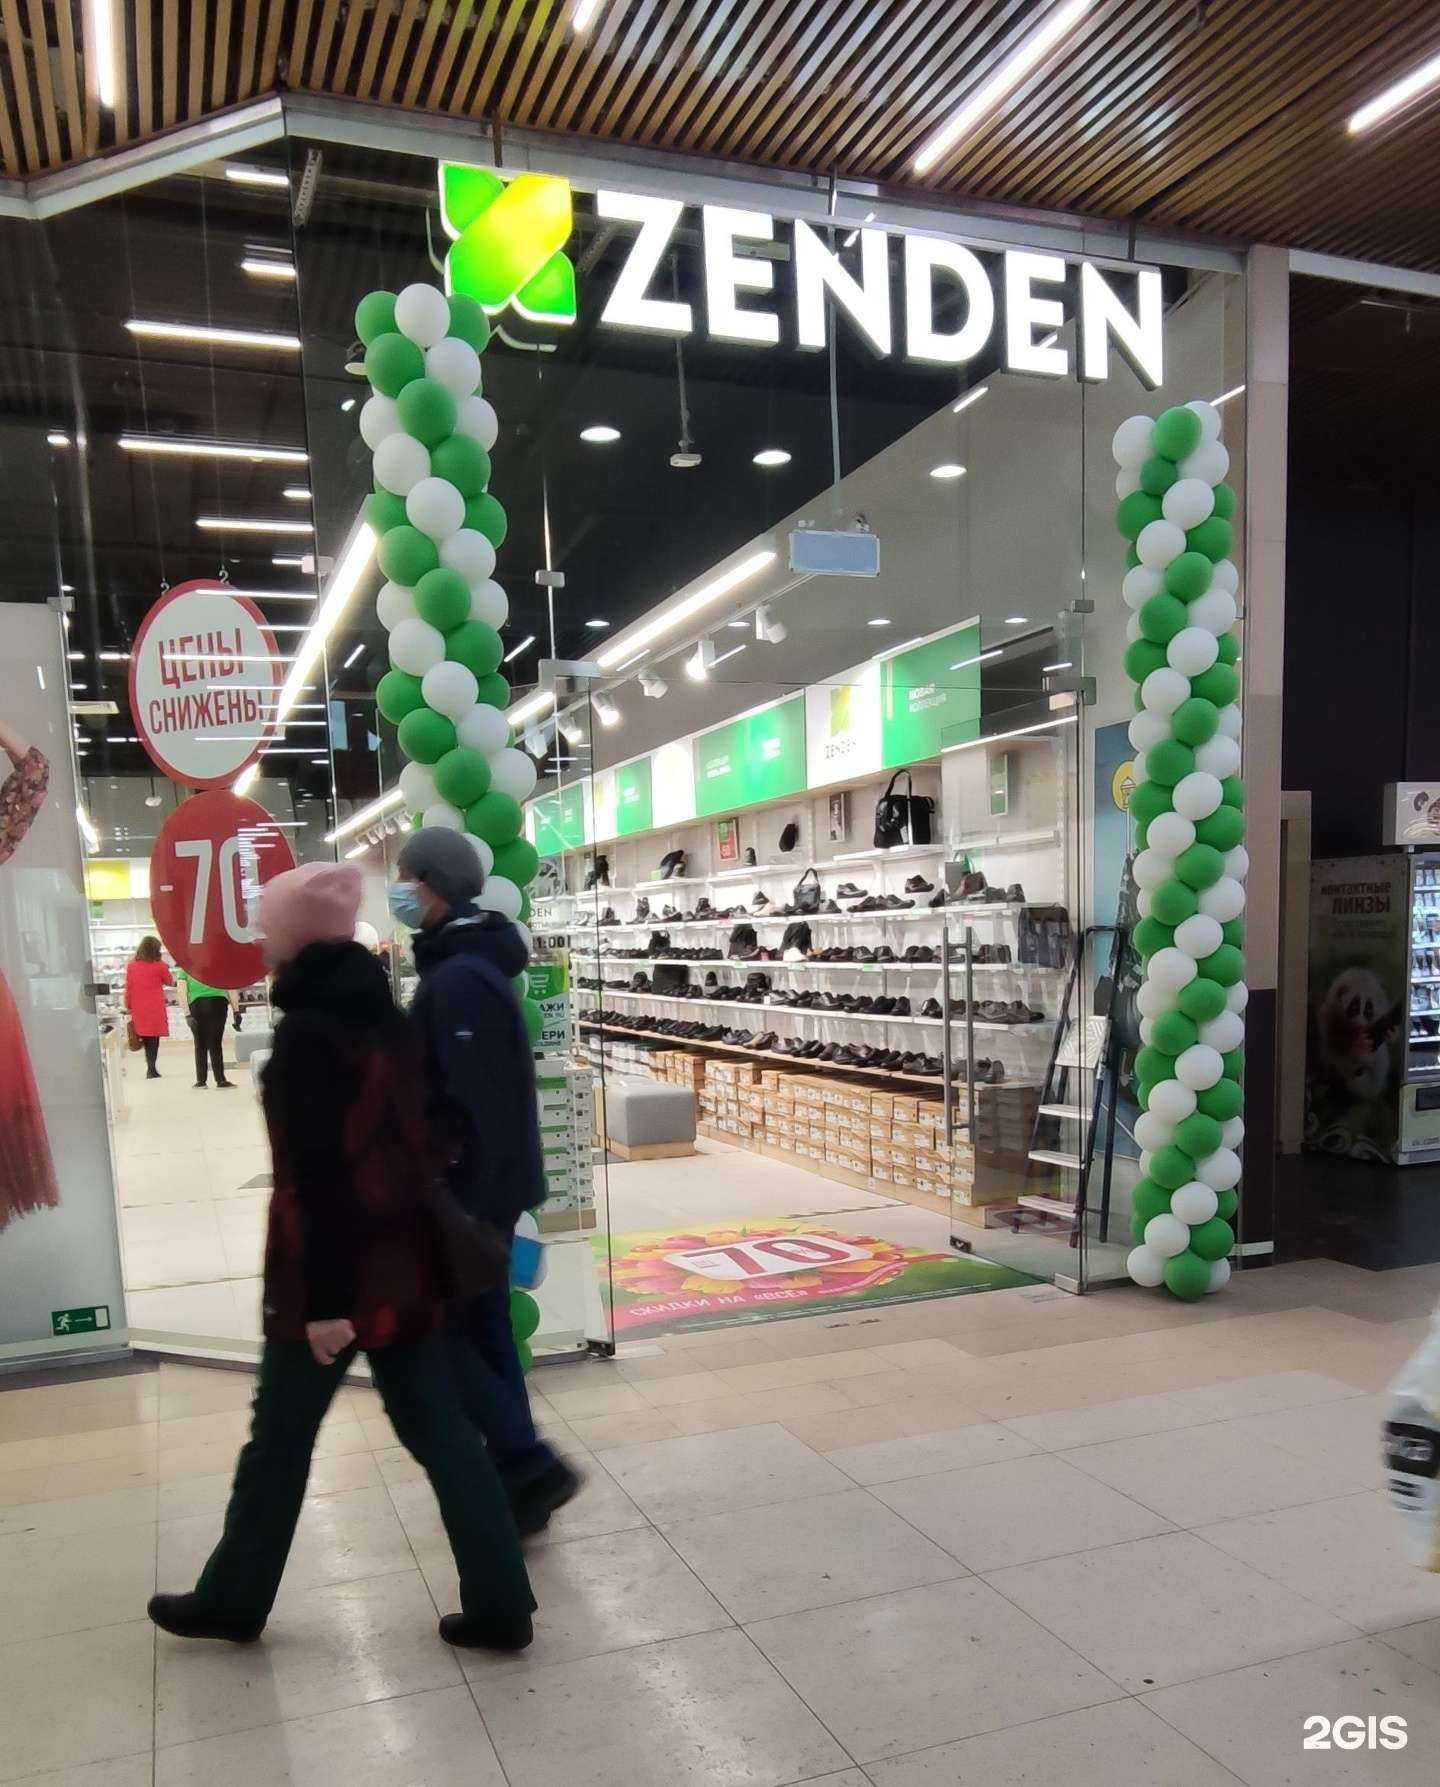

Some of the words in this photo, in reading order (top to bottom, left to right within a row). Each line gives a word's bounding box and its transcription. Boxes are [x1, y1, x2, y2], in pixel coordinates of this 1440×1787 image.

[596, 188, 1164, 390] ZENDEN
[158, 627, 244, 690] ЦЕНЫ
[149, 689, 264, 735] СНИЖЕНЫ
[532, 936, 565, 949] 1:00
[681, 1238, 852, 1276] 70
[629, 1298, 712, 1318] СКИДКИ
[718, 1294, 747, 1306] НА
